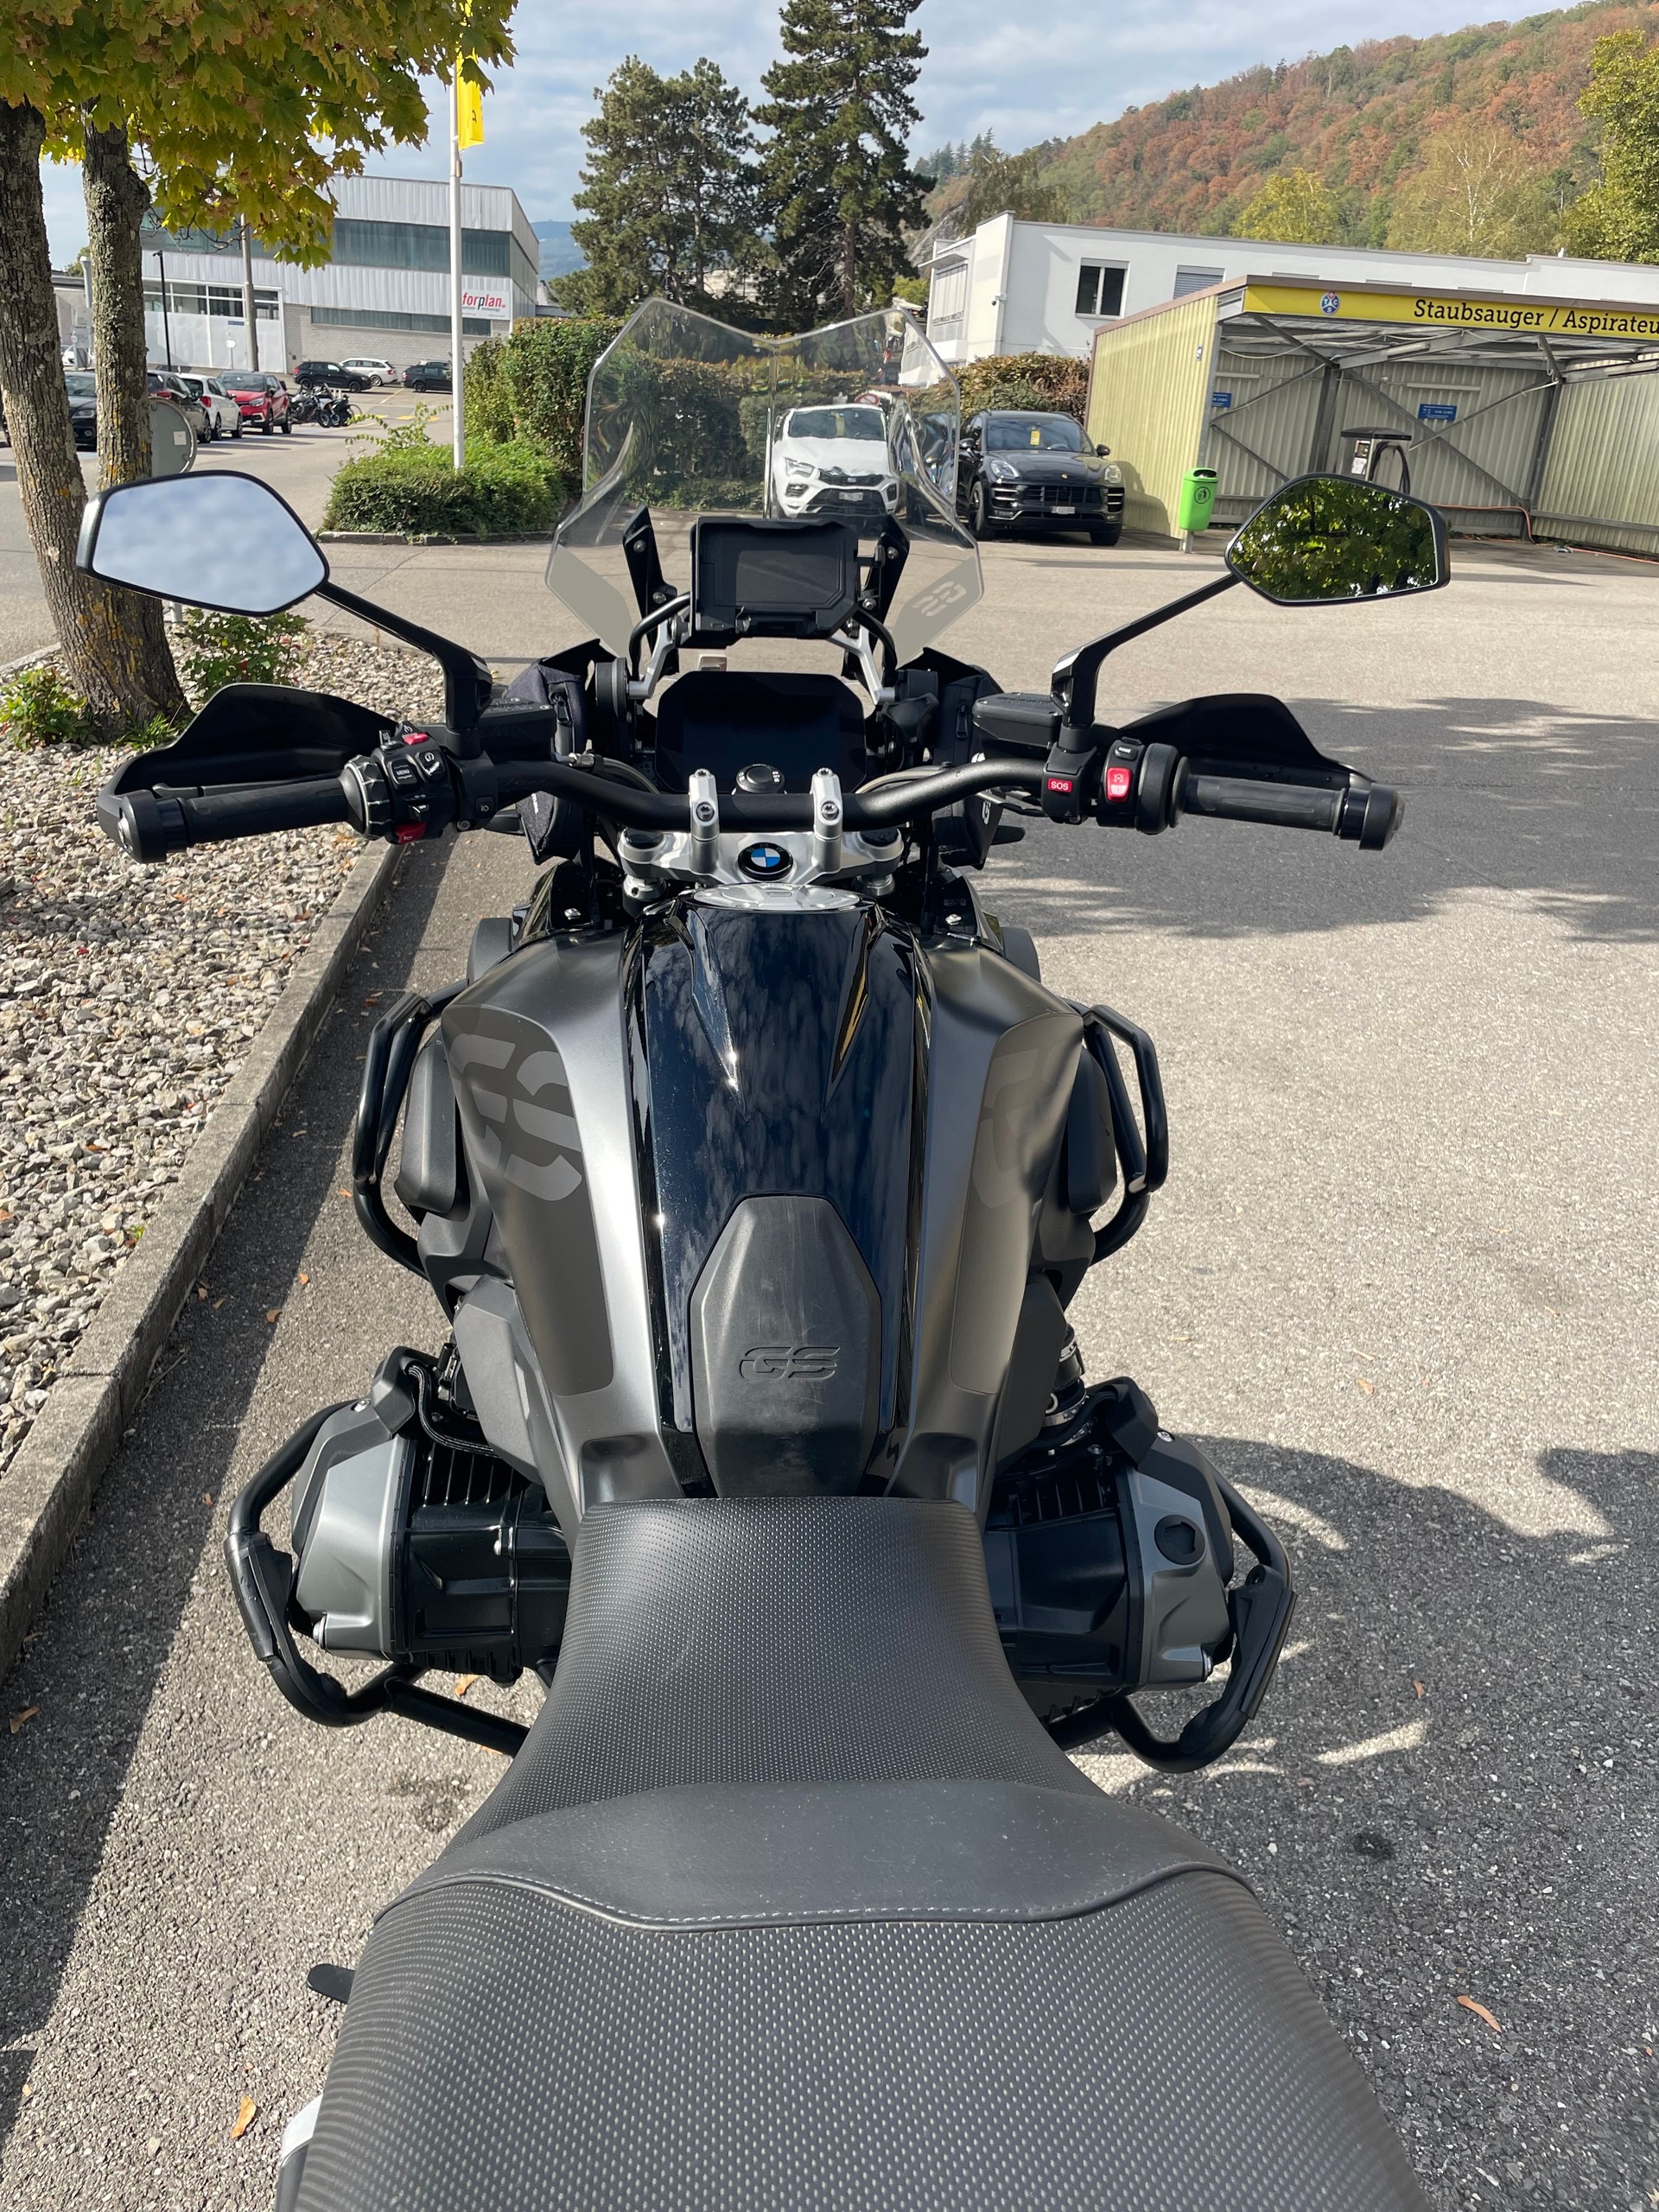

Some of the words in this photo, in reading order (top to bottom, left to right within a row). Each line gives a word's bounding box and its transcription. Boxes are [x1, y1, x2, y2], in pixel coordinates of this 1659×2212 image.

[462, 292, 502, 310] forplan
[1414, 299, 1544, 328] Staubsauger
[1548, 308, 1560, 328] /
[1051, 780, 1069, 791] SOS
[739, 1346, 840, 1380] GS
